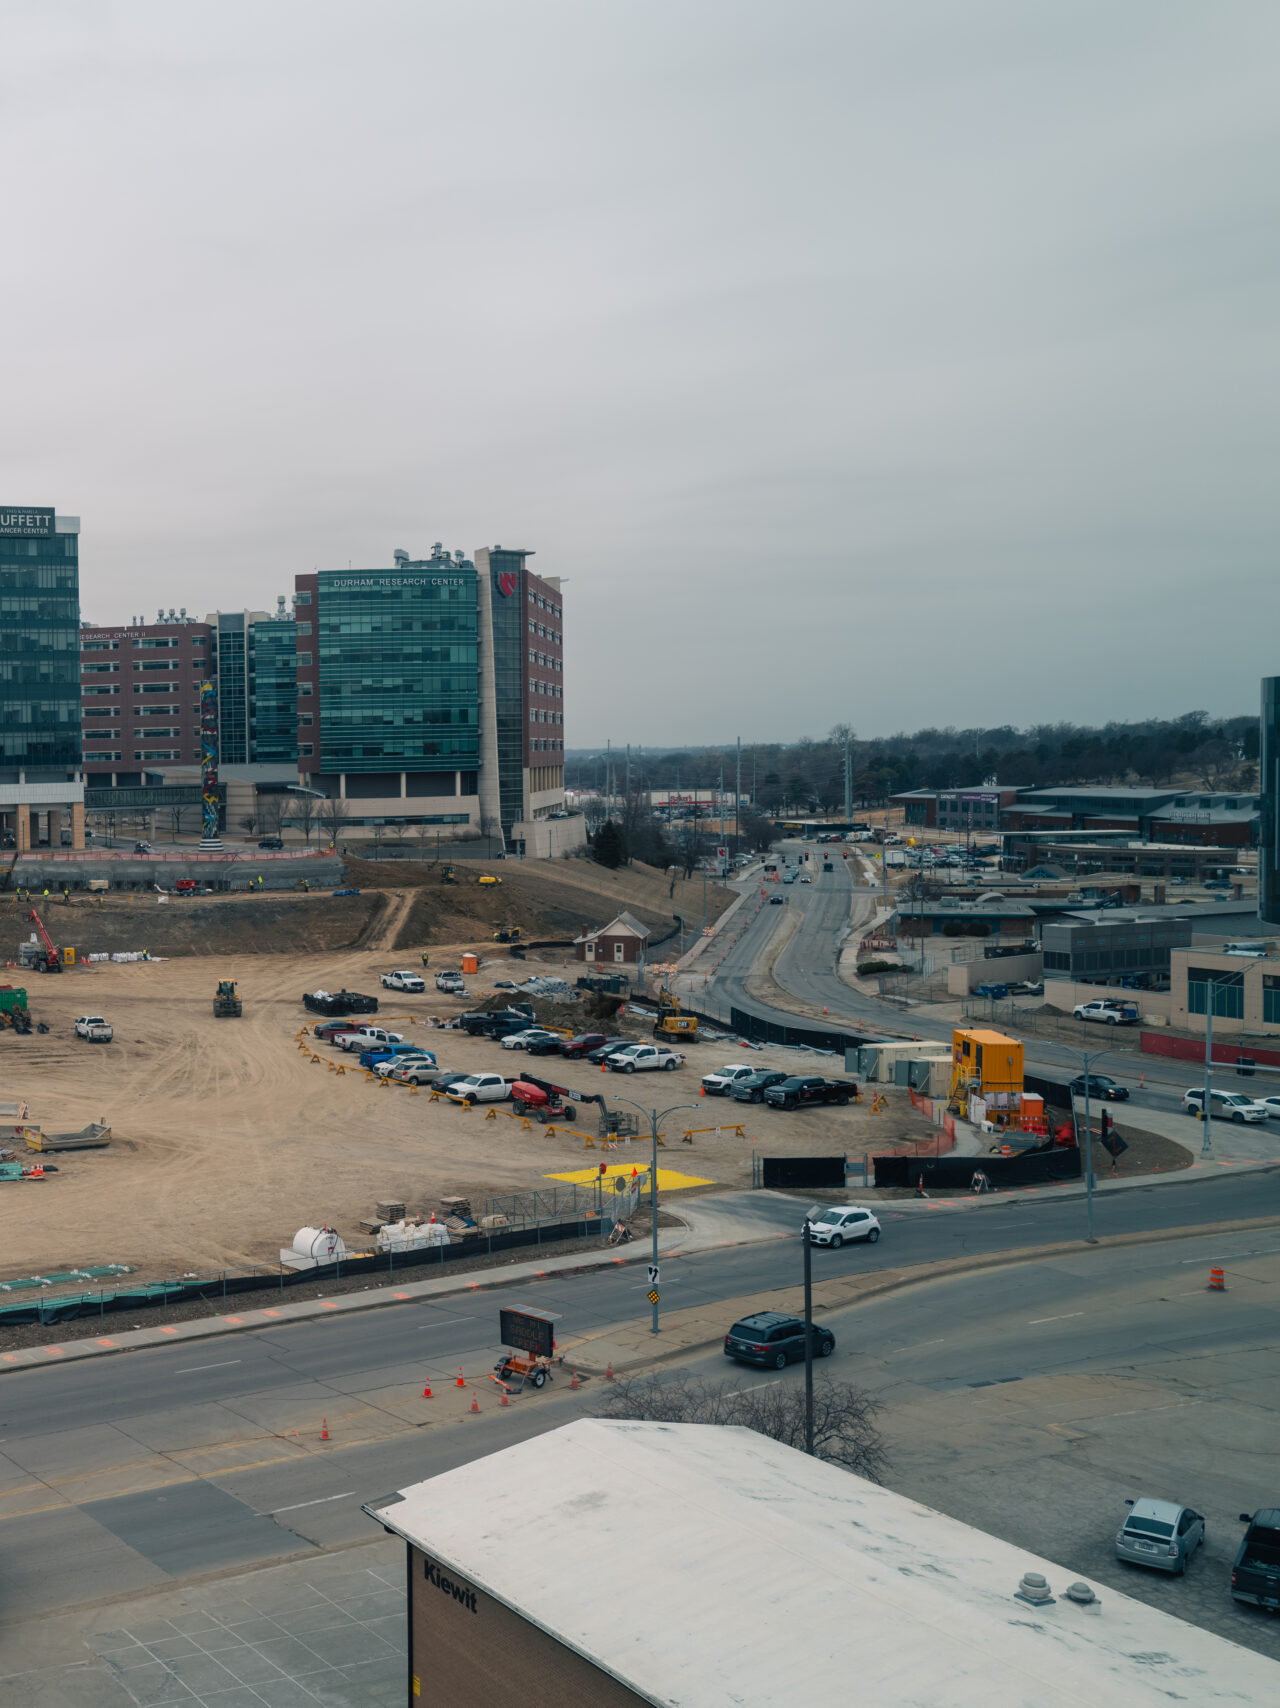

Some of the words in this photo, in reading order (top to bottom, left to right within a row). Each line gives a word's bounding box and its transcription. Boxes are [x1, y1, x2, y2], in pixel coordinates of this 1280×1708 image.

[23, 527, 49, 535] CENTER
[333, 579, 374, 587] DURHAM
[379, 578, 426, 586] RESEARCH
[431, 578, 465, 586] CENTER
[677, 1021, 688, 1029] CAT
[423, 1558, 478, 1615] Kiewit
